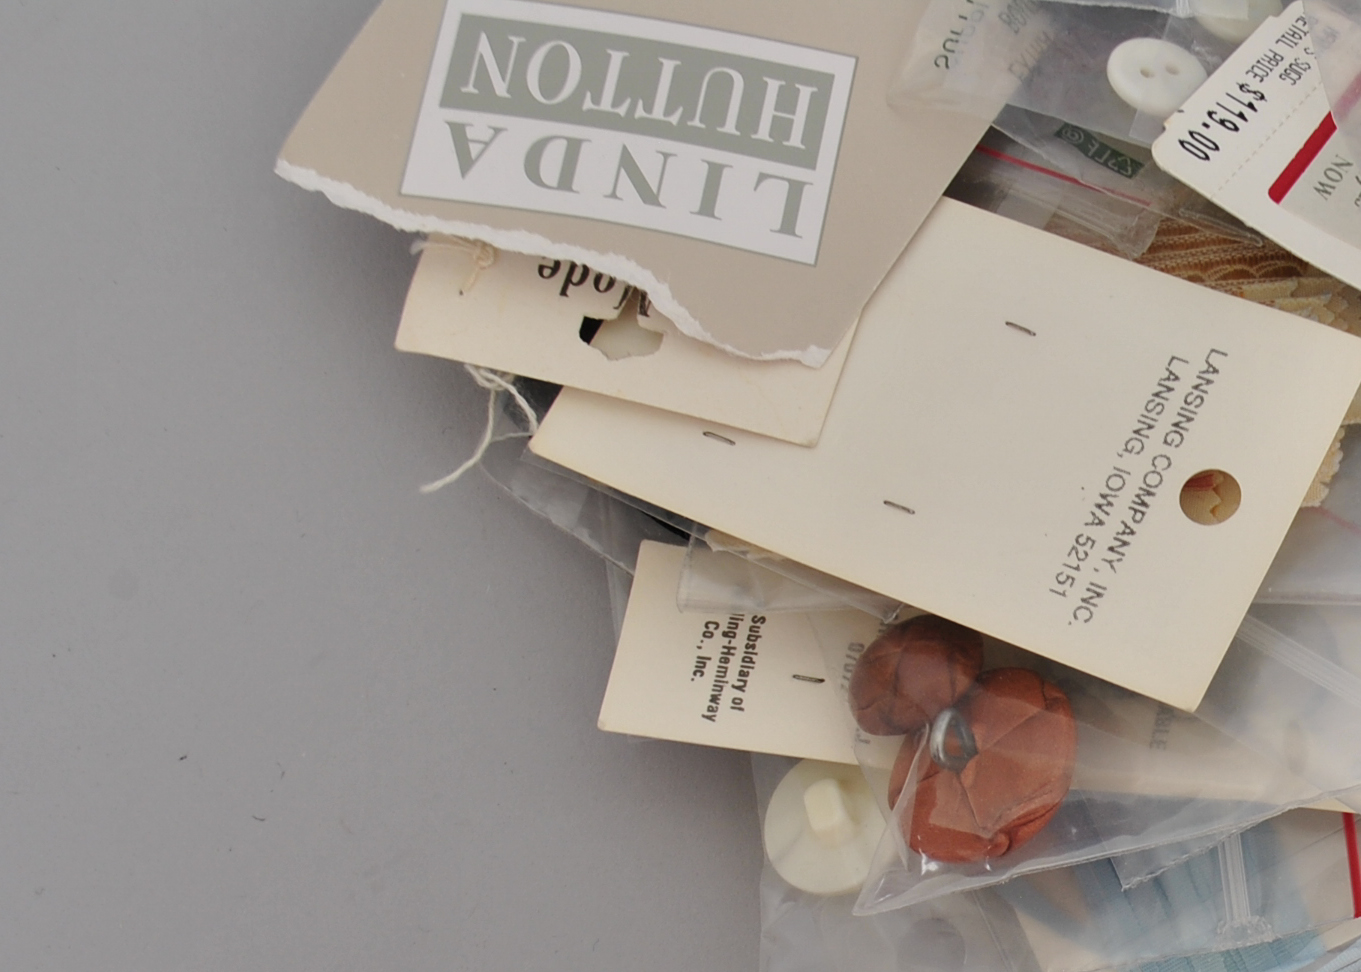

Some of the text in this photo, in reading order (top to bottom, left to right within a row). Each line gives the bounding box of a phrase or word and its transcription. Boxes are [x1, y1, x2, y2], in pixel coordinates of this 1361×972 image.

[460, 31, 819, 150] HUTTON
[1245, 49, 1285, 83] PRICE
[1178, 82, 1267, 161] $119.00
[445, 119, 815, 240] LINDA
[1312, 154, 1354, 200] NOW
[1163, 348, 1228, 448] LANSING
[1049, 355, 1190, 598] LANSING, IOWA 52151
[1068, 582, 1107, 626] INC.
[690, 620, 720, 682] Co., Inc.
[730, 614, 766, 712] Subsidiary of
